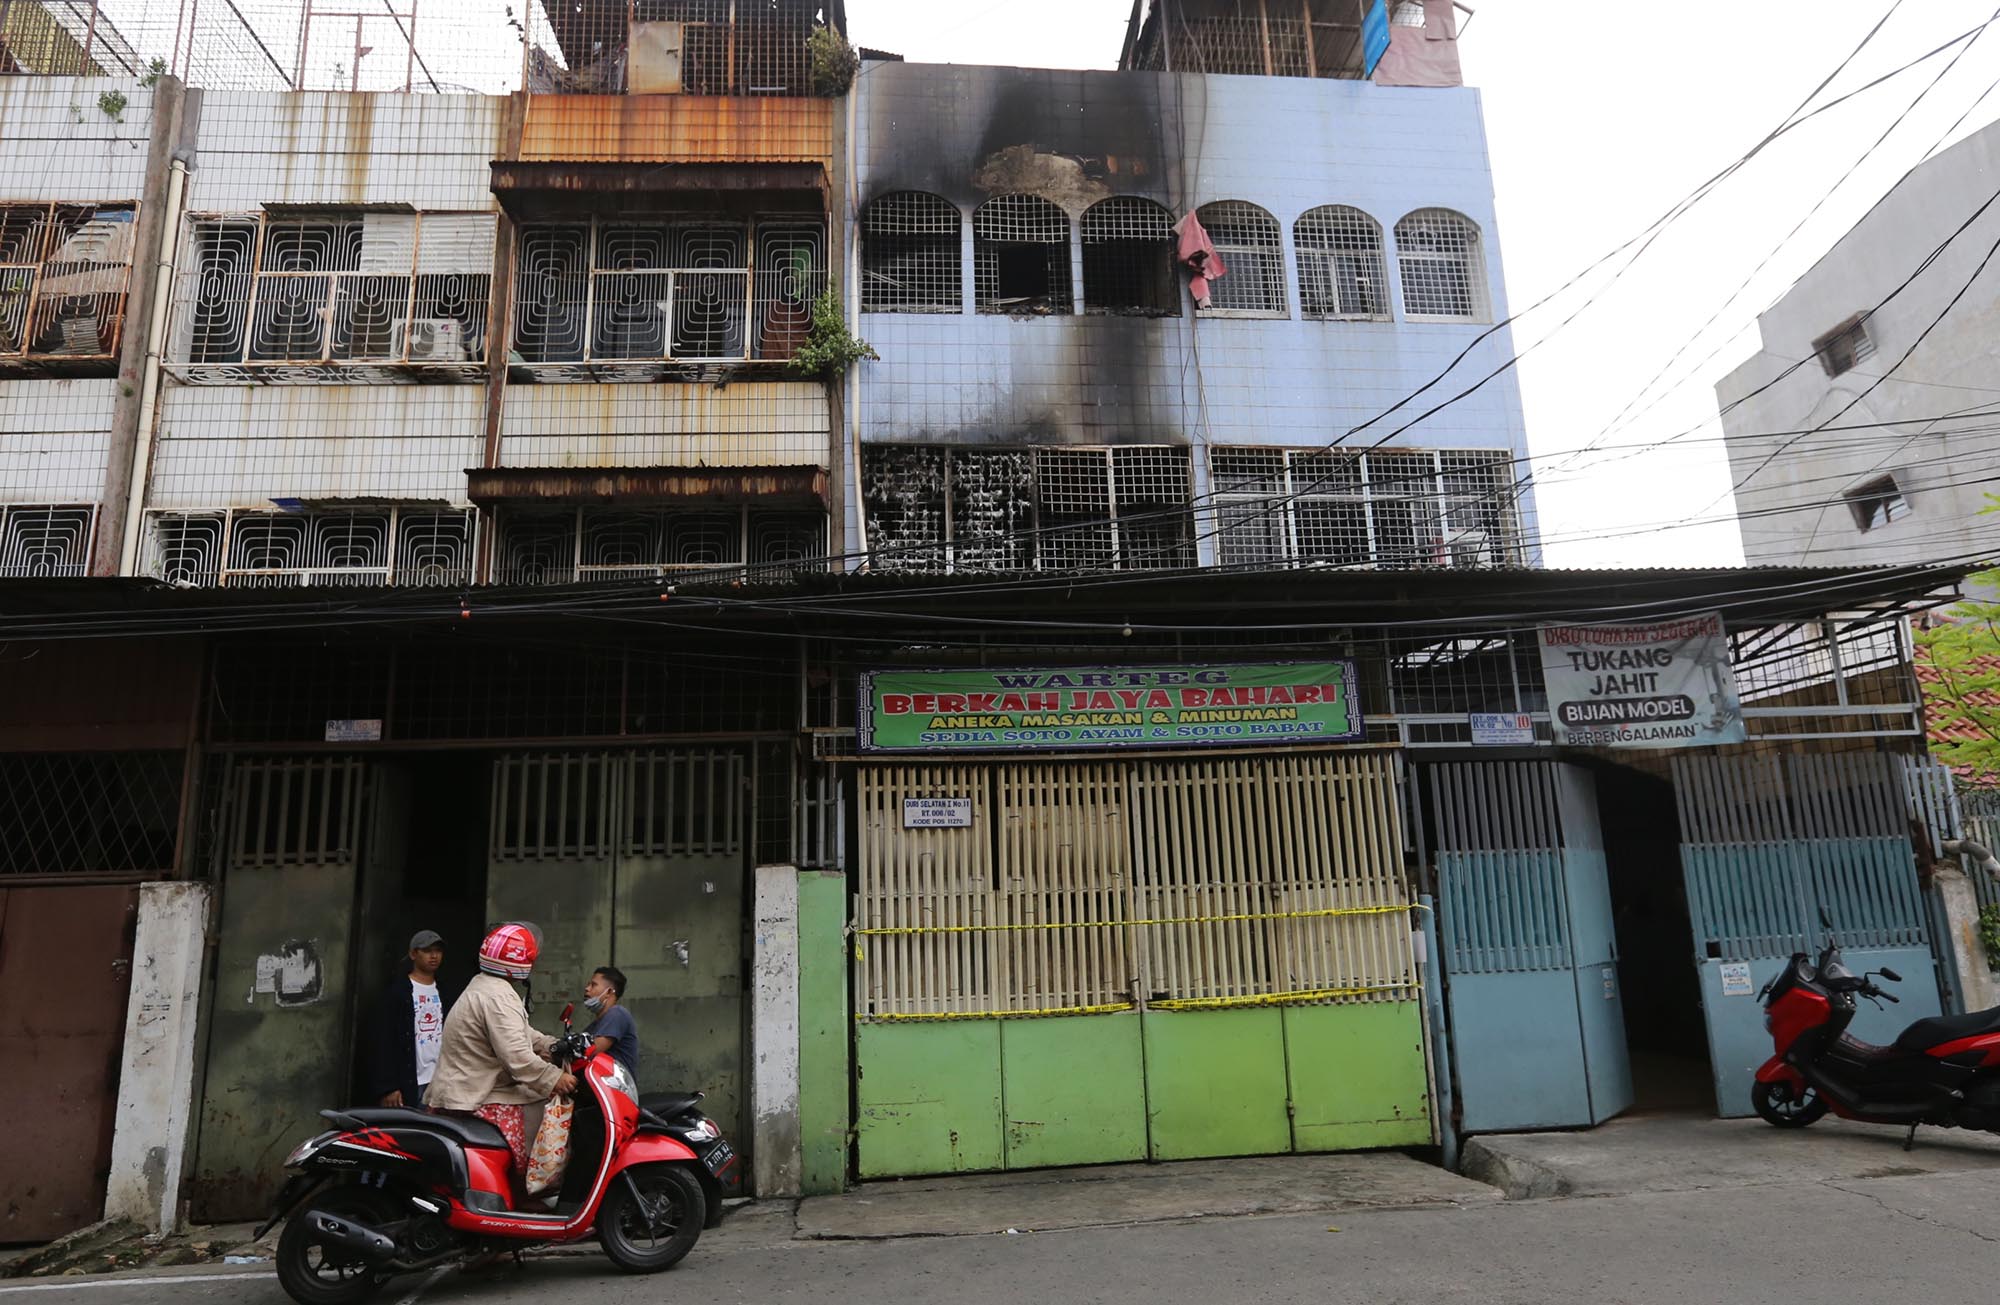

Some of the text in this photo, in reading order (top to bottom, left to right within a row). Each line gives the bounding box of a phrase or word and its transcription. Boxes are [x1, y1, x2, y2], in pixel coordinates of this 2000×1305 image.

[1567, 649, 1673, 672] TUKANG
[993, 671, 1229, 689] WARTEG
[1590, 672, 1660, 695] JAHIT
[881, 684, 1336, 715] BERKAH JAYA BAHARI
[1566, 699, 1690, 721] BIJIAN MODEL
[928, 707, 1297, 730] ANEKA MASAKAN & MINUMAN
[920, 721, 1324, 743] SEDIA SOTO AYAM & SOTO BABAT
[1567, 725, 1696, 745] BERPENGALAMAN
